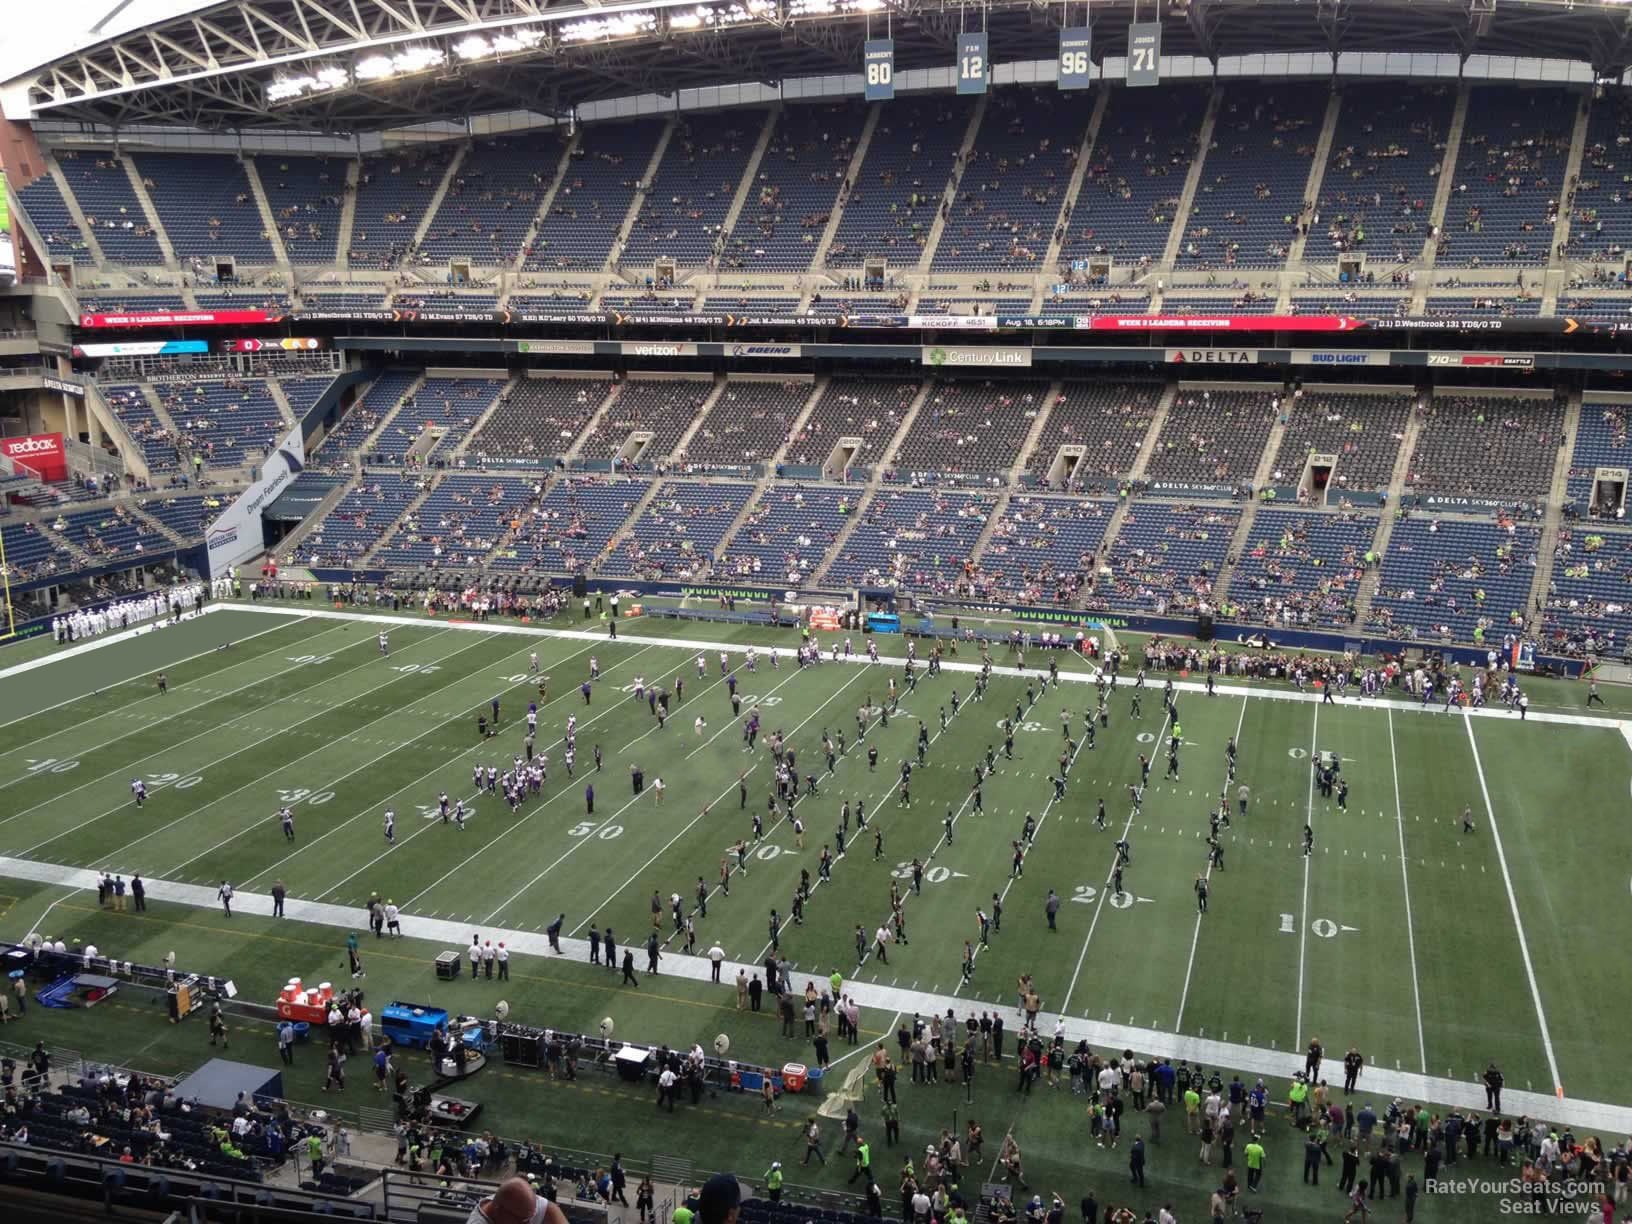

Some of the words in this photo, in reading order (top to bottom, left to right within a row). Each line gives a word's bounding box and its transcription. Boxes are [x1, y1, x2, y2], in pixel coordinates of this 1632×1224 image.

[965, 45, 980, 53] FAN
[1062, 52, 1087, 74] 96
[1132, 48, 1154, 71] 71
[961, 56, 983, 79] 12
[868, 63, 891, 85] 80
[1074, 260, 1085, 270] 12
[1056, 284, 1066, 294] 12
[1394, 320, 1445, 328] D.Westbrook
[1446, 320, 1460, 328] 131
[634, 344, 678, 356] verizon
[950, 351, 1023, 364] CenturyLink
[1192, 351, 1249, 362] DELTA
[1312, 354, 1335, 363] BUD
[1335, 354, 1368, 363] LIGHT
[1429, 355, 1450, 364] 710
[146, 373, 198, 382] BROTHERTON
[1437, 496, 1468, 505] DELTA
[280, 788, 336, 806] 30
[567, 820, 625, 841] 50
[1071, 885, 1134, 909] 20
[1278, 913, 1338, 938] 10
[282, 1004, 292, 1016] G
[788, 1077, 797, 1087] G
